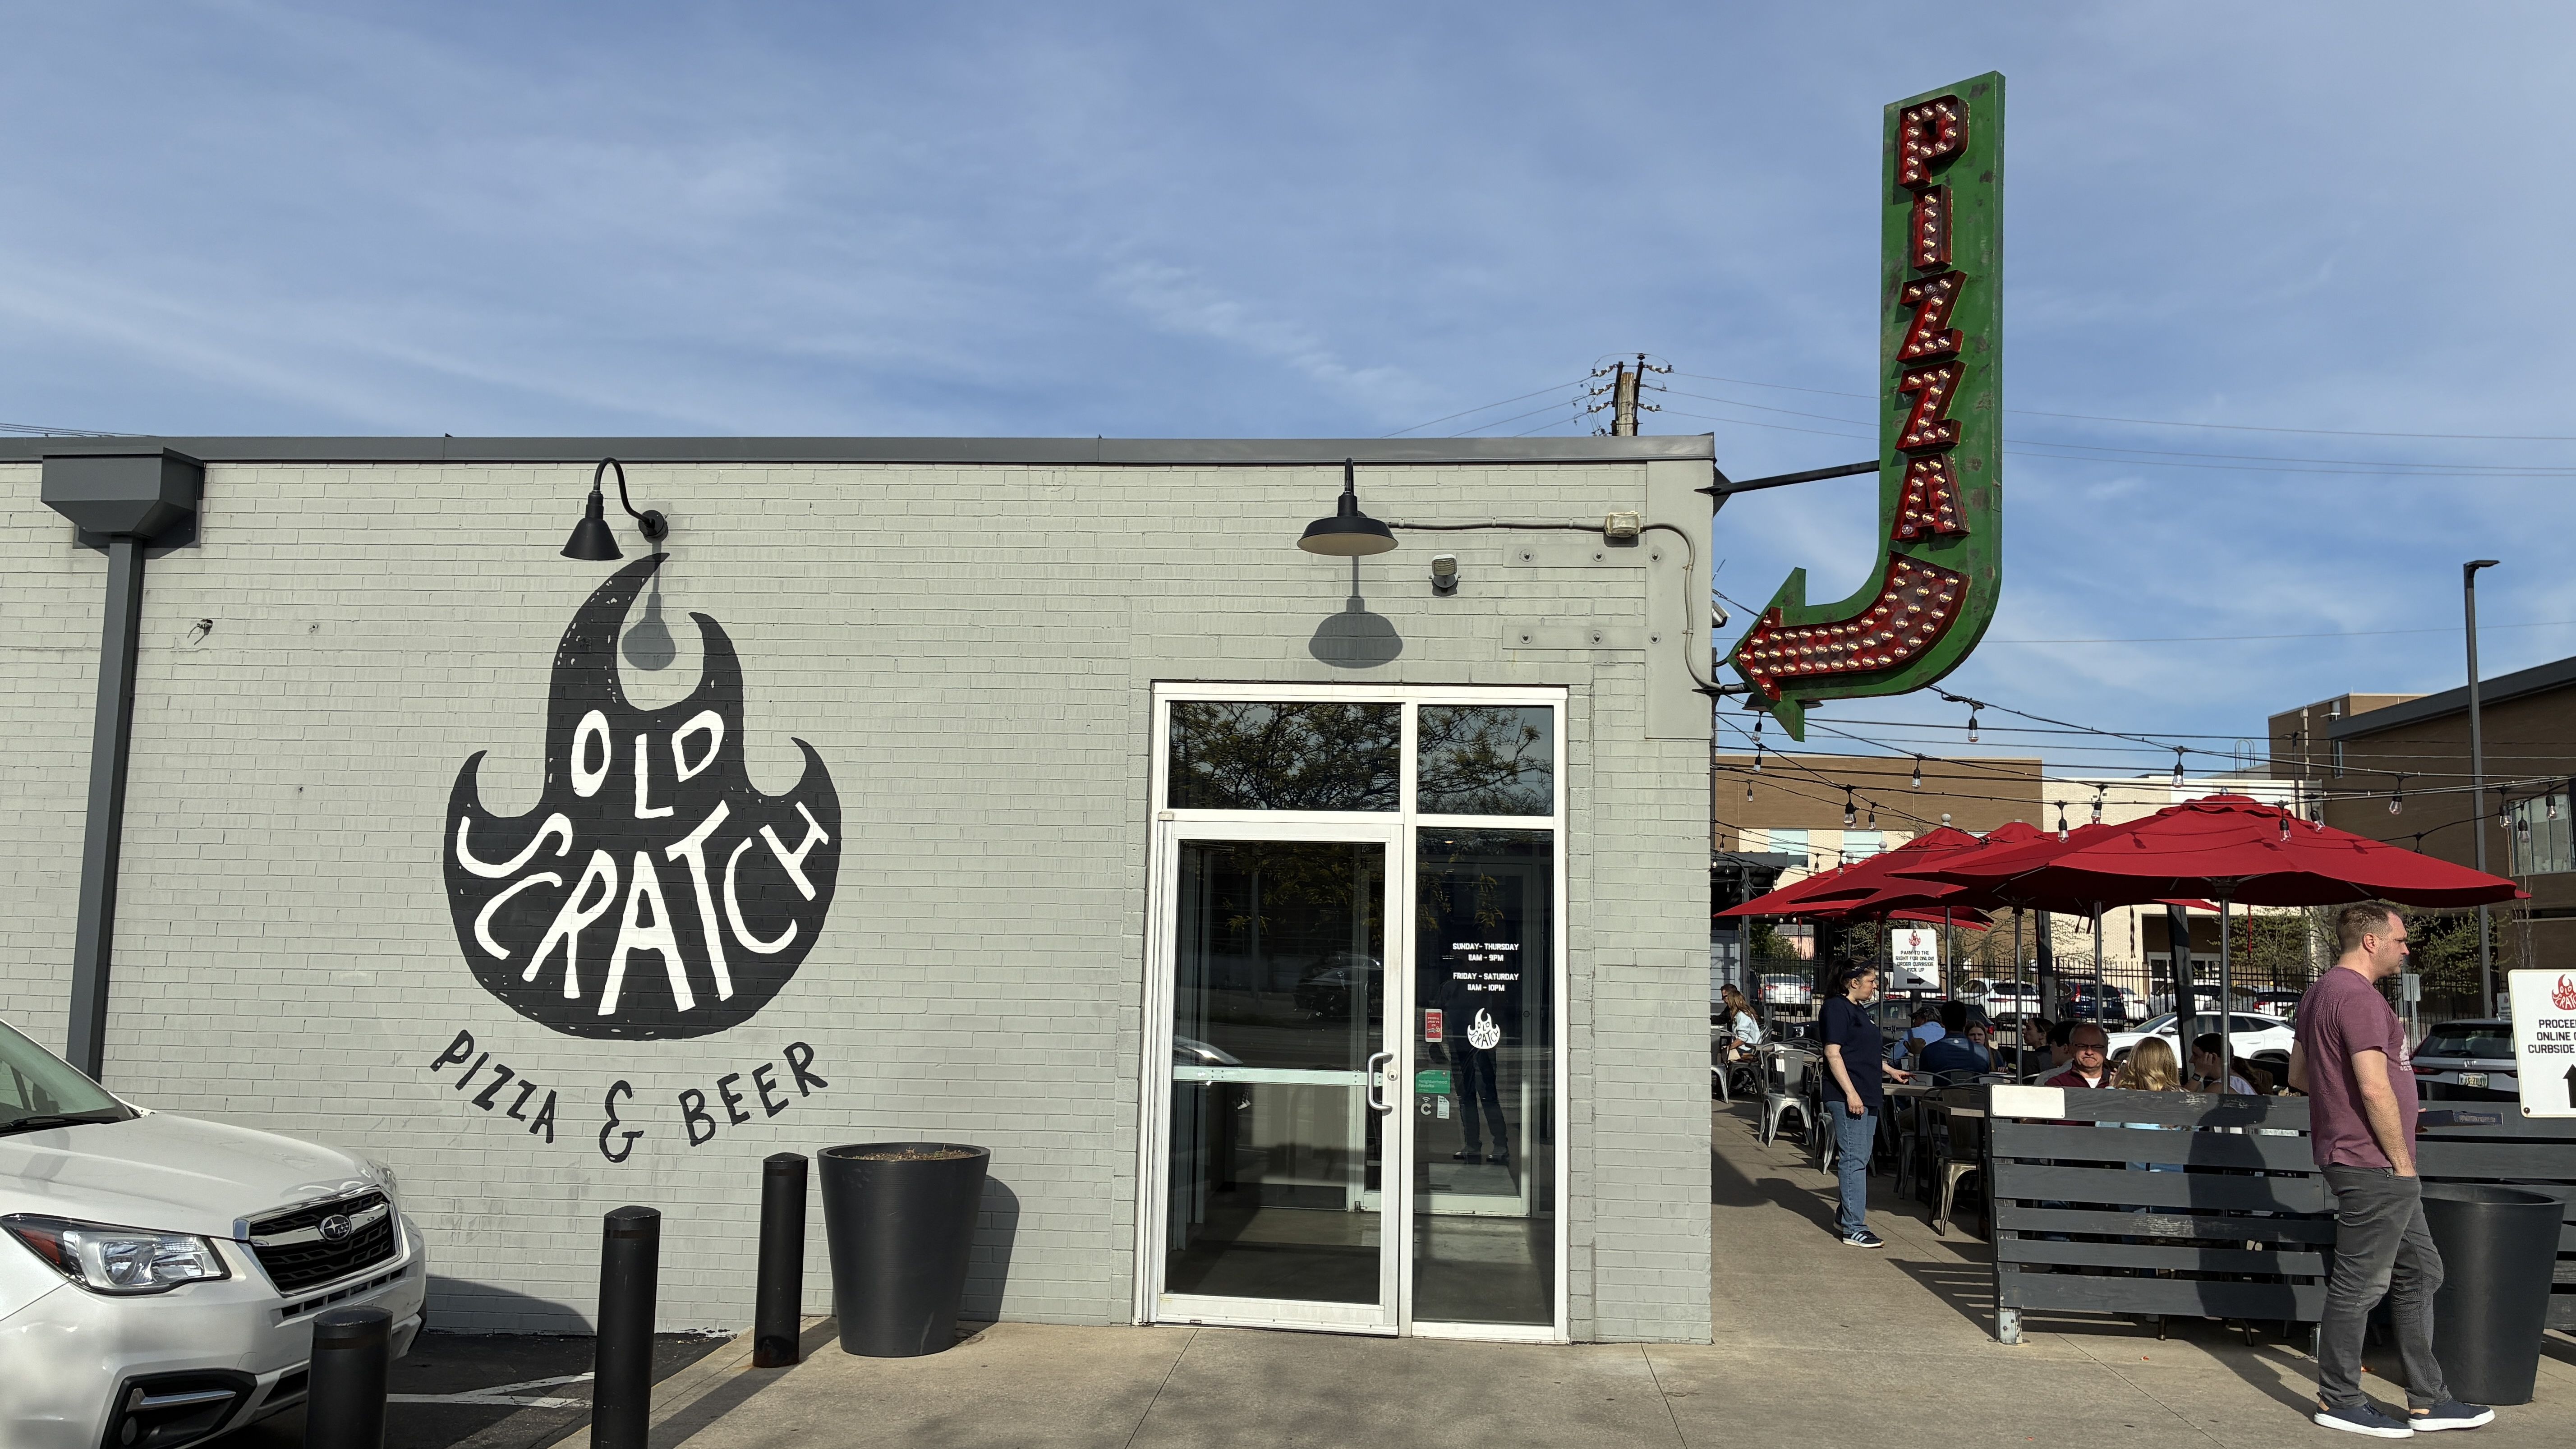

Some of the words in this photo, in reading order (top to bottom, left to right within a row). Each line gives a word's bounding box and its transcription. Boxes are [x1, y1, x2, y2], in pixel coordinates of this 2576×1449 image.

[1891, 94, 1970, 542] PIZZA
[571, 710, 724, 819] OLD
[456, 800, 830, 1016] SCRATCH
[2560, 985, 2572, 995] OLD
[2552, 993, 2576, 1009] SCRATC
[1477, 1021, 1490, 1031] OLD
[2539, 1019, 2576, 1029] PROCEE
[1468, 1029, 1498, 1047] SCRATCH
[2537, 1031, 2571, 1041] ONLINE
[2528, 1044, 2576, 1053] CURBSIDE
[430, 1029, 558, 1144] PIZZA
[599, 1079, 644, 1164] &
[678, 1041, 828, 1148] BEER
